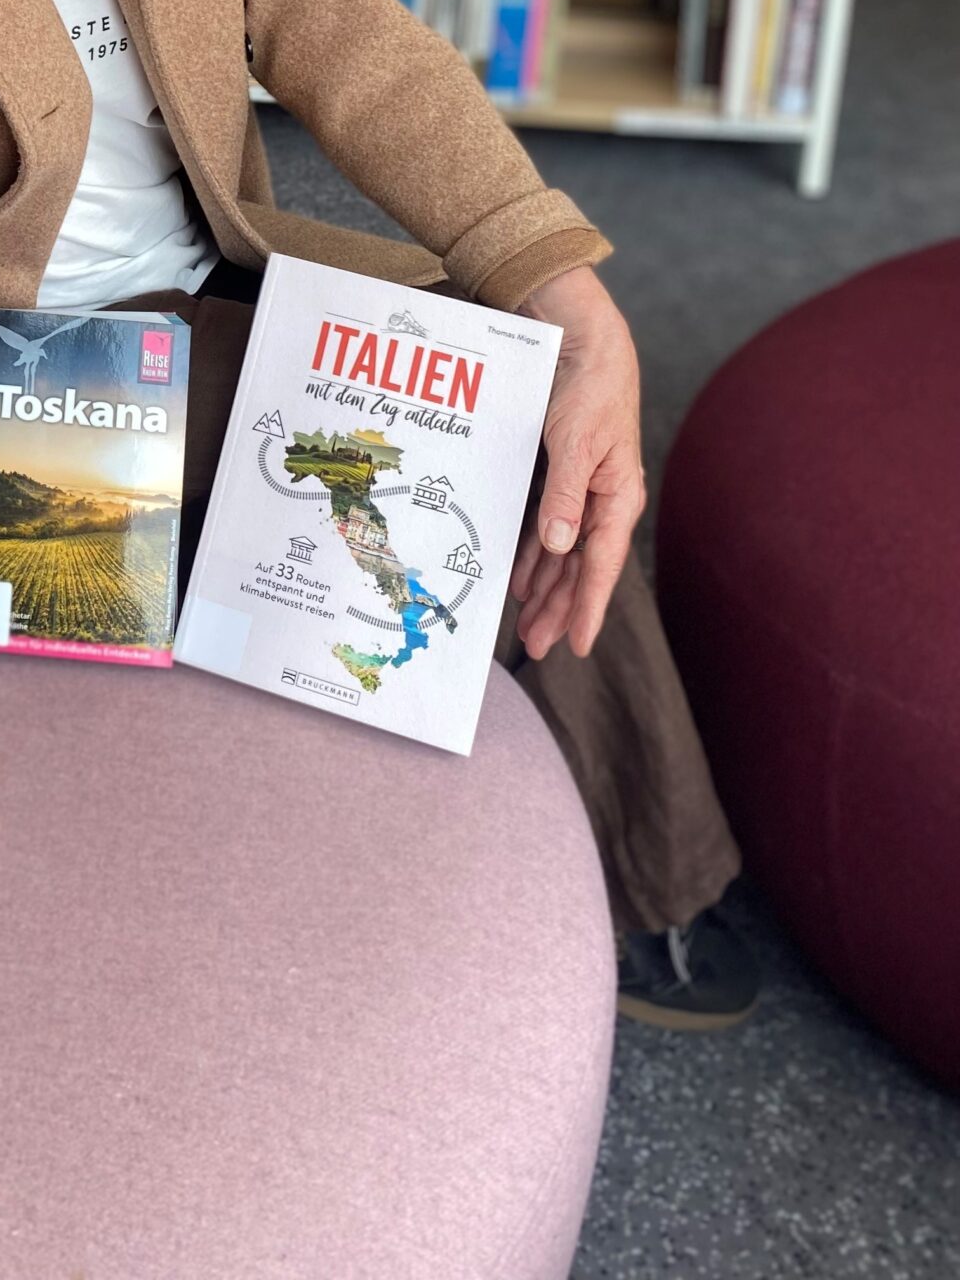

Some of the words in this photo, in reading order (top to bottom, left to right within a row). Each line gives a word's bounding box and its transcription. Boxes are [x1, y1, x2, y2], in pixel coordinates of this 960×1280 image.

[88, 38, 128, 61] 1975
[488, 326, 516, 340] Thomas
[517, 333, 541, 347] Migge
[143, 350, 169, 368] REISE
[311, 320, 485, 414] ITALIEN
[306, 380, 335, 401] mit
[335, 385, 366, 412] dem
[369, 393, 401, 427] Zug
[404, 408, 473, 439] entdecken
[255, 562, 274, 575] Auf
[275, 563, 295, 580] 33
[296, 573, 331, 593] Routen
[255, 575, 304, 598] entspannt
[306, 591, 325, 604] und
[240, 582, 304, 611] klimabewusst
[305, 604, 335, 621] reisen
[302, 678, 355, 700] BRUCKMANN
